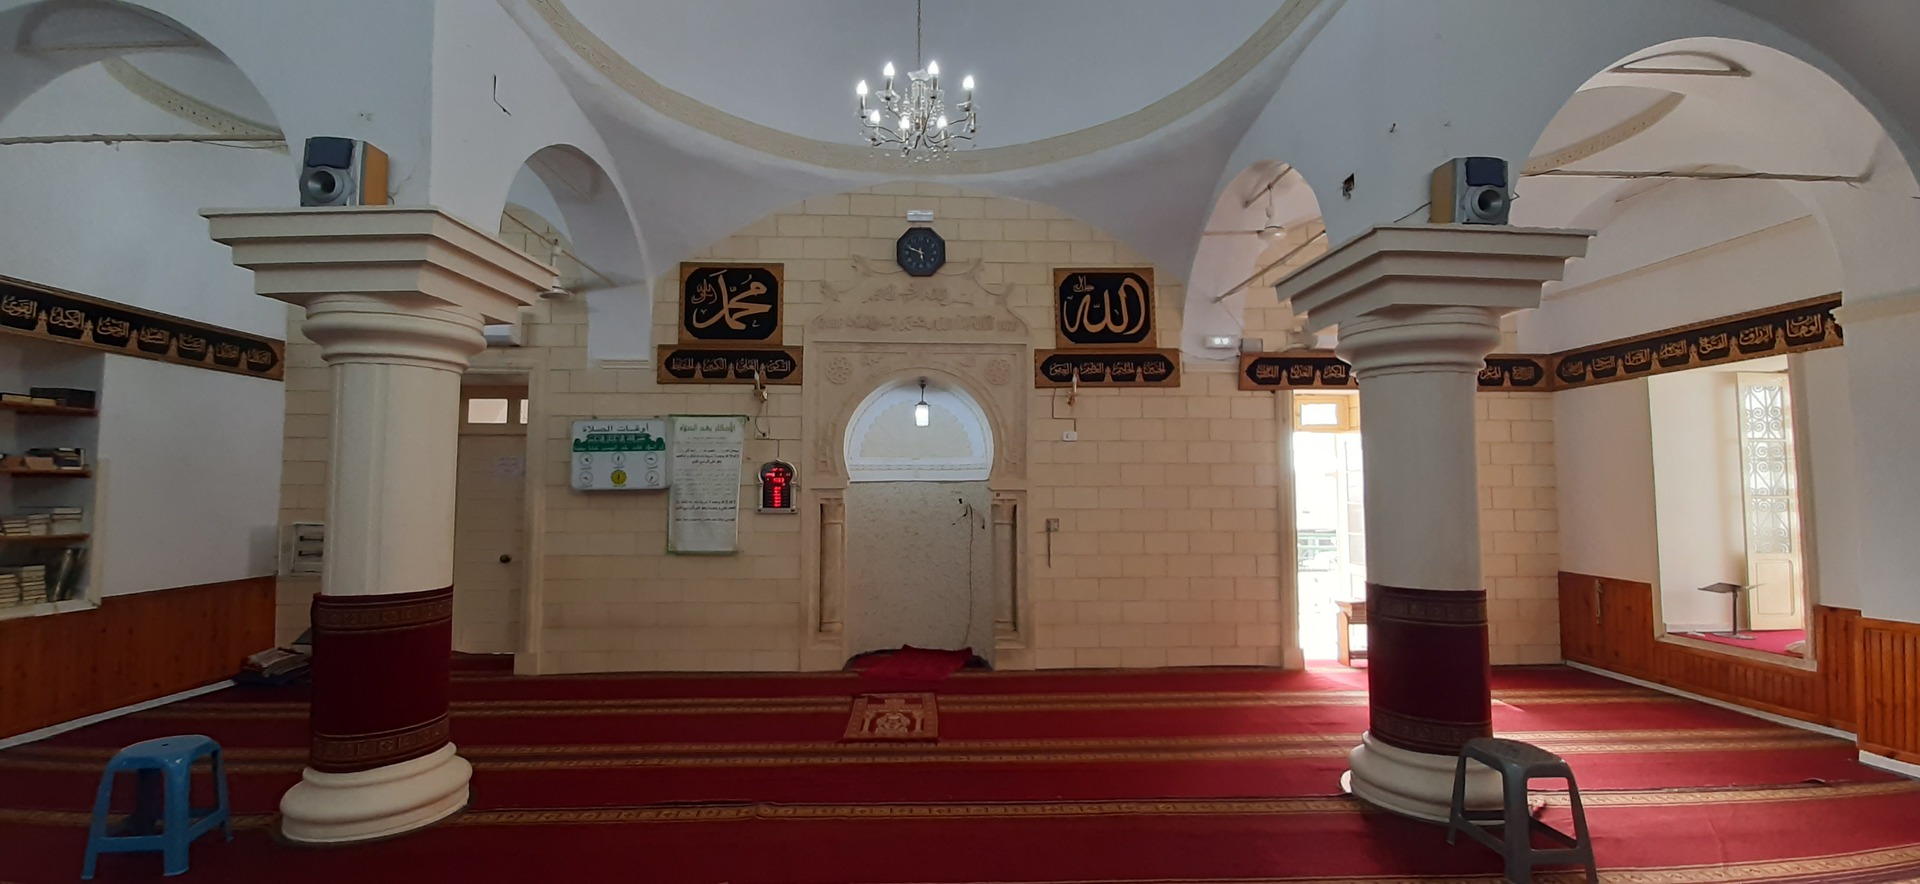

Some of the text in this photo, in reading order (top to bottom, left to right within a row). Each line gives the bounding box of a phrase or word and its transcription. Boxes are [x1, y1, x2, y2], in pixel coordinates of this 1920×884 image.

[1, 293, 39, 320] القوي
[1062, 276, 1146, 336] الله
[49, 306, 86, 331] الوكيل
[1785, 313, 1823, 338] الوهاب
[1698, 332, 1728, 355] الفتاح
[1738, 323, 1773, 347] الرزاق
[702, 357, 727, 373] الكبير
[582, 422, 649, 433] أوقات الصلاة
